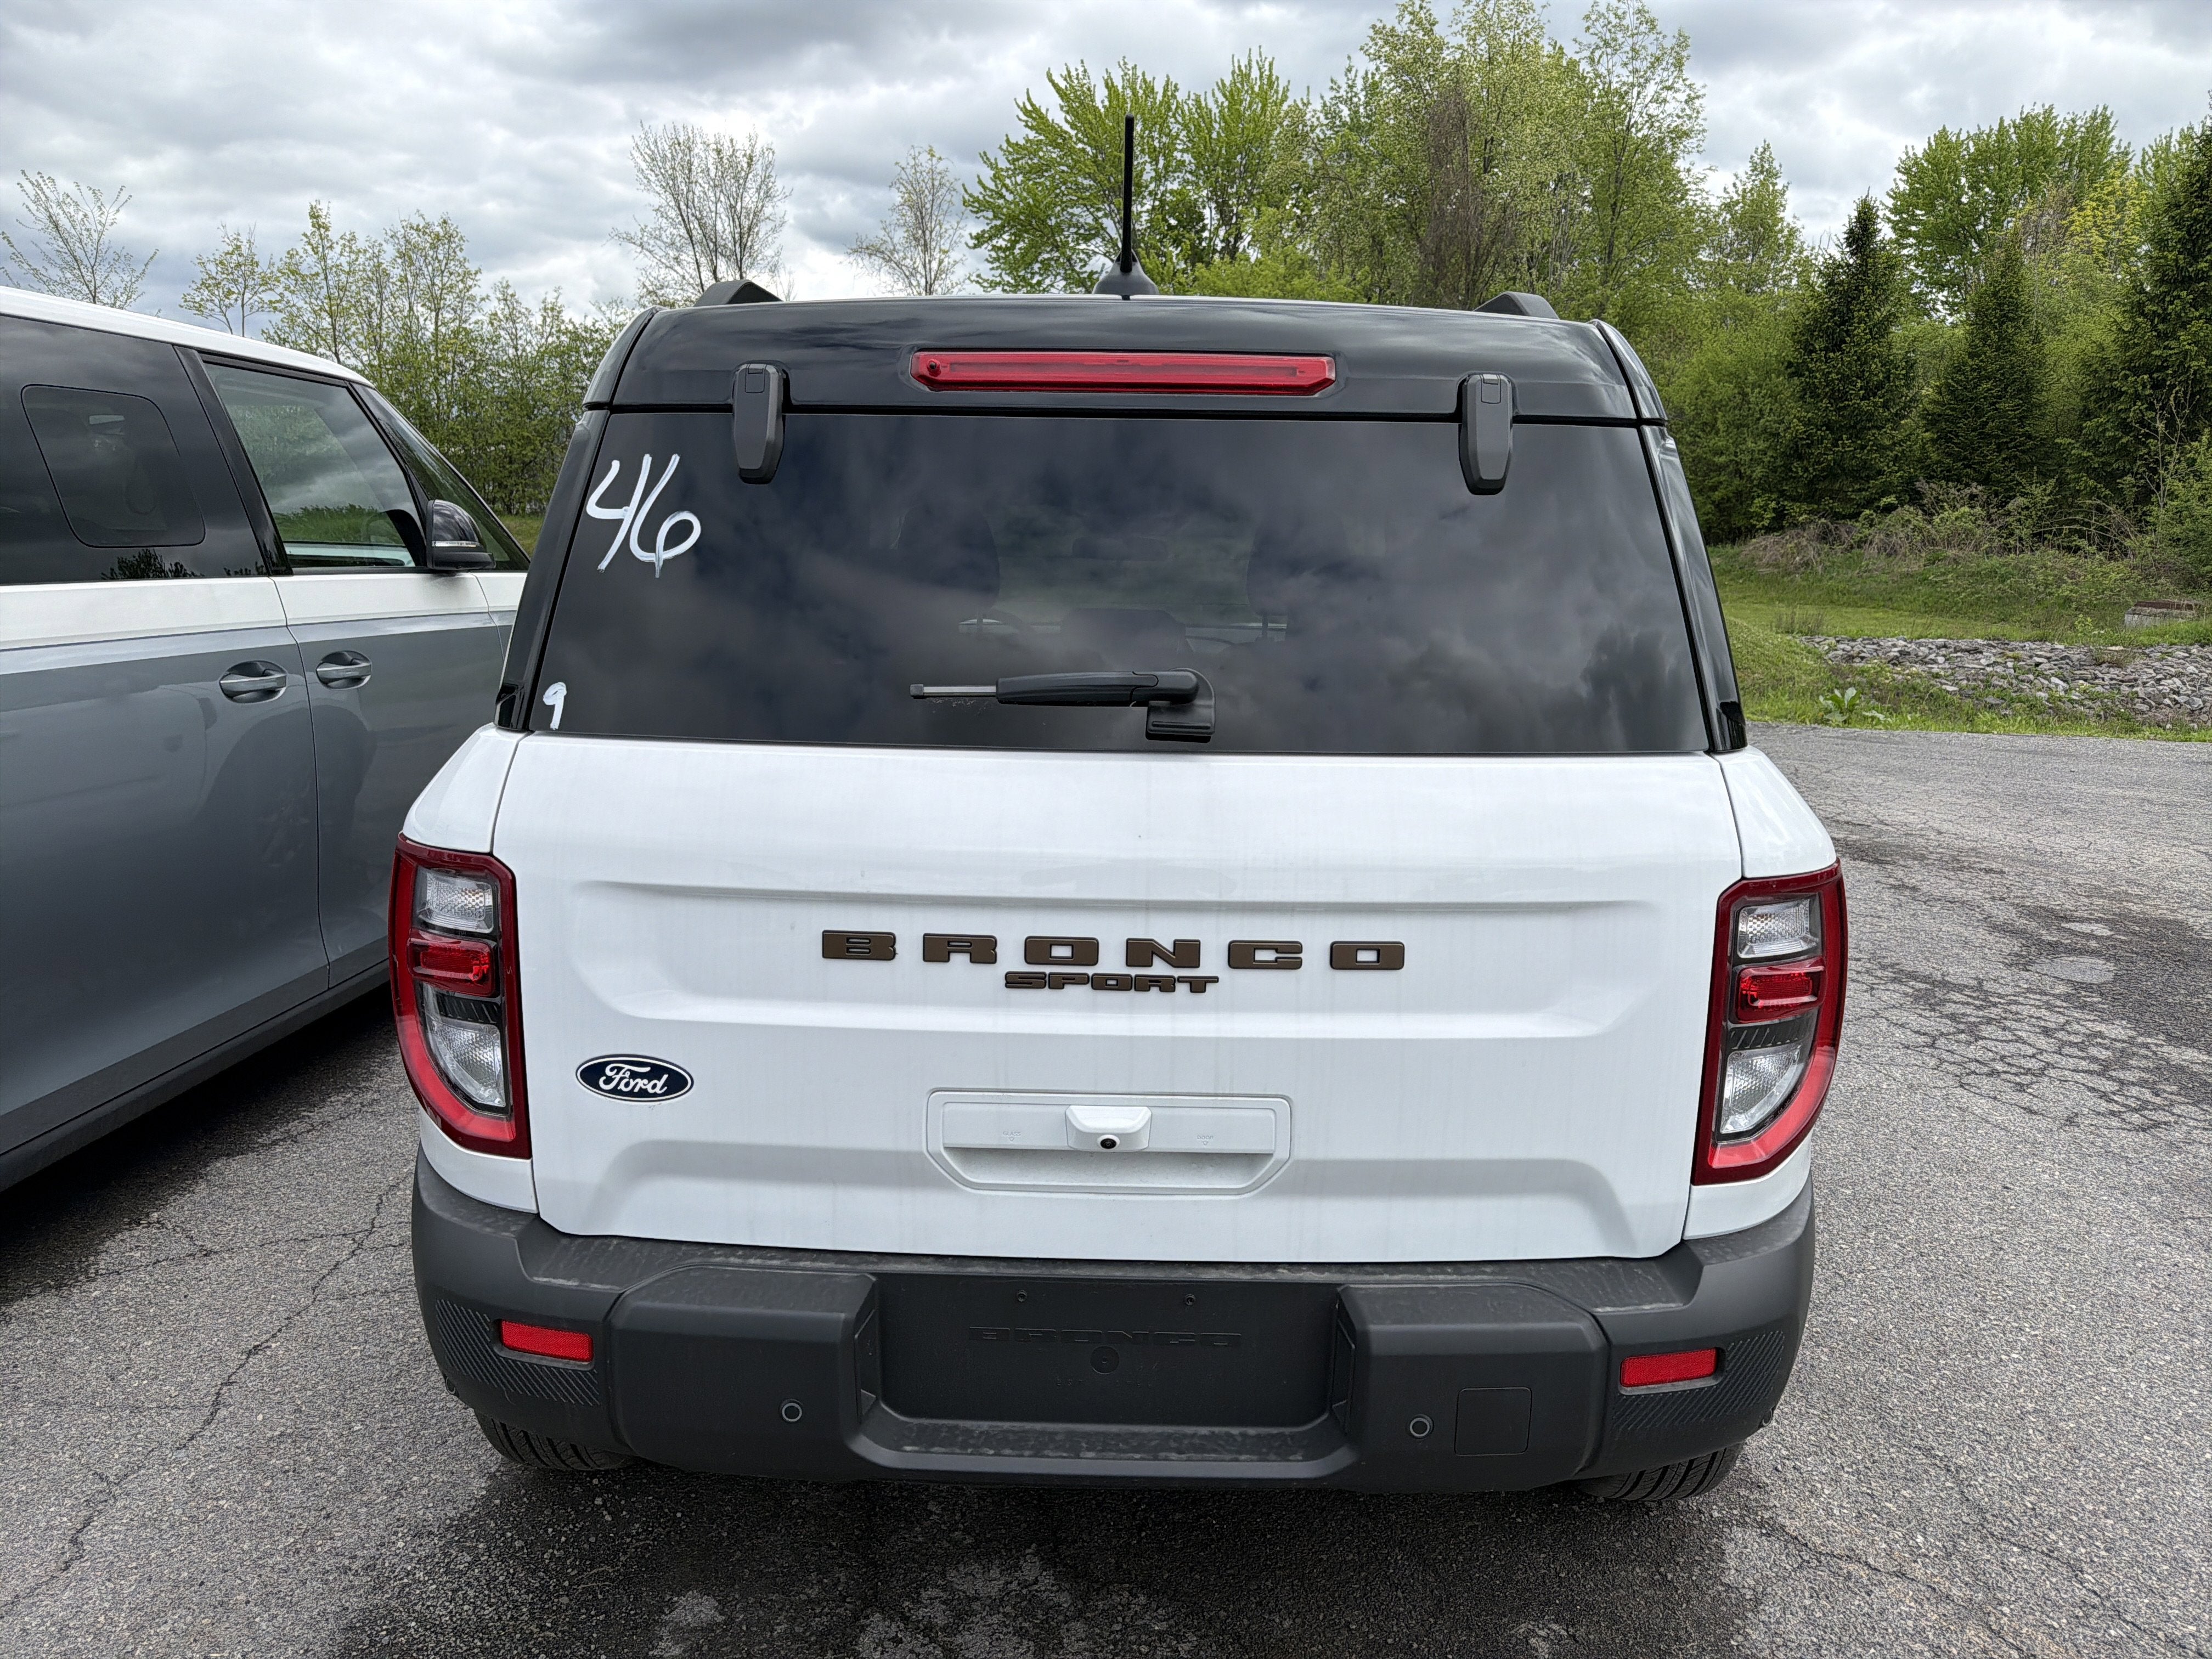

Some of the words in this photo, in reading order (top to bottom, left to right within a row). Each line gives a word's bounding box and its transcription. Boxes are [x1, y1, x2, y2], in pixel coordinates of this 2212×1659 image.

[586, 454, 701, 578] 46
[543, 681, 567, 730] 9
[822, 929, 1405, 970] BRONCO
[1005, 972, 1219, 993] SPORT
[599, 1063, 669, 1094] Ford
